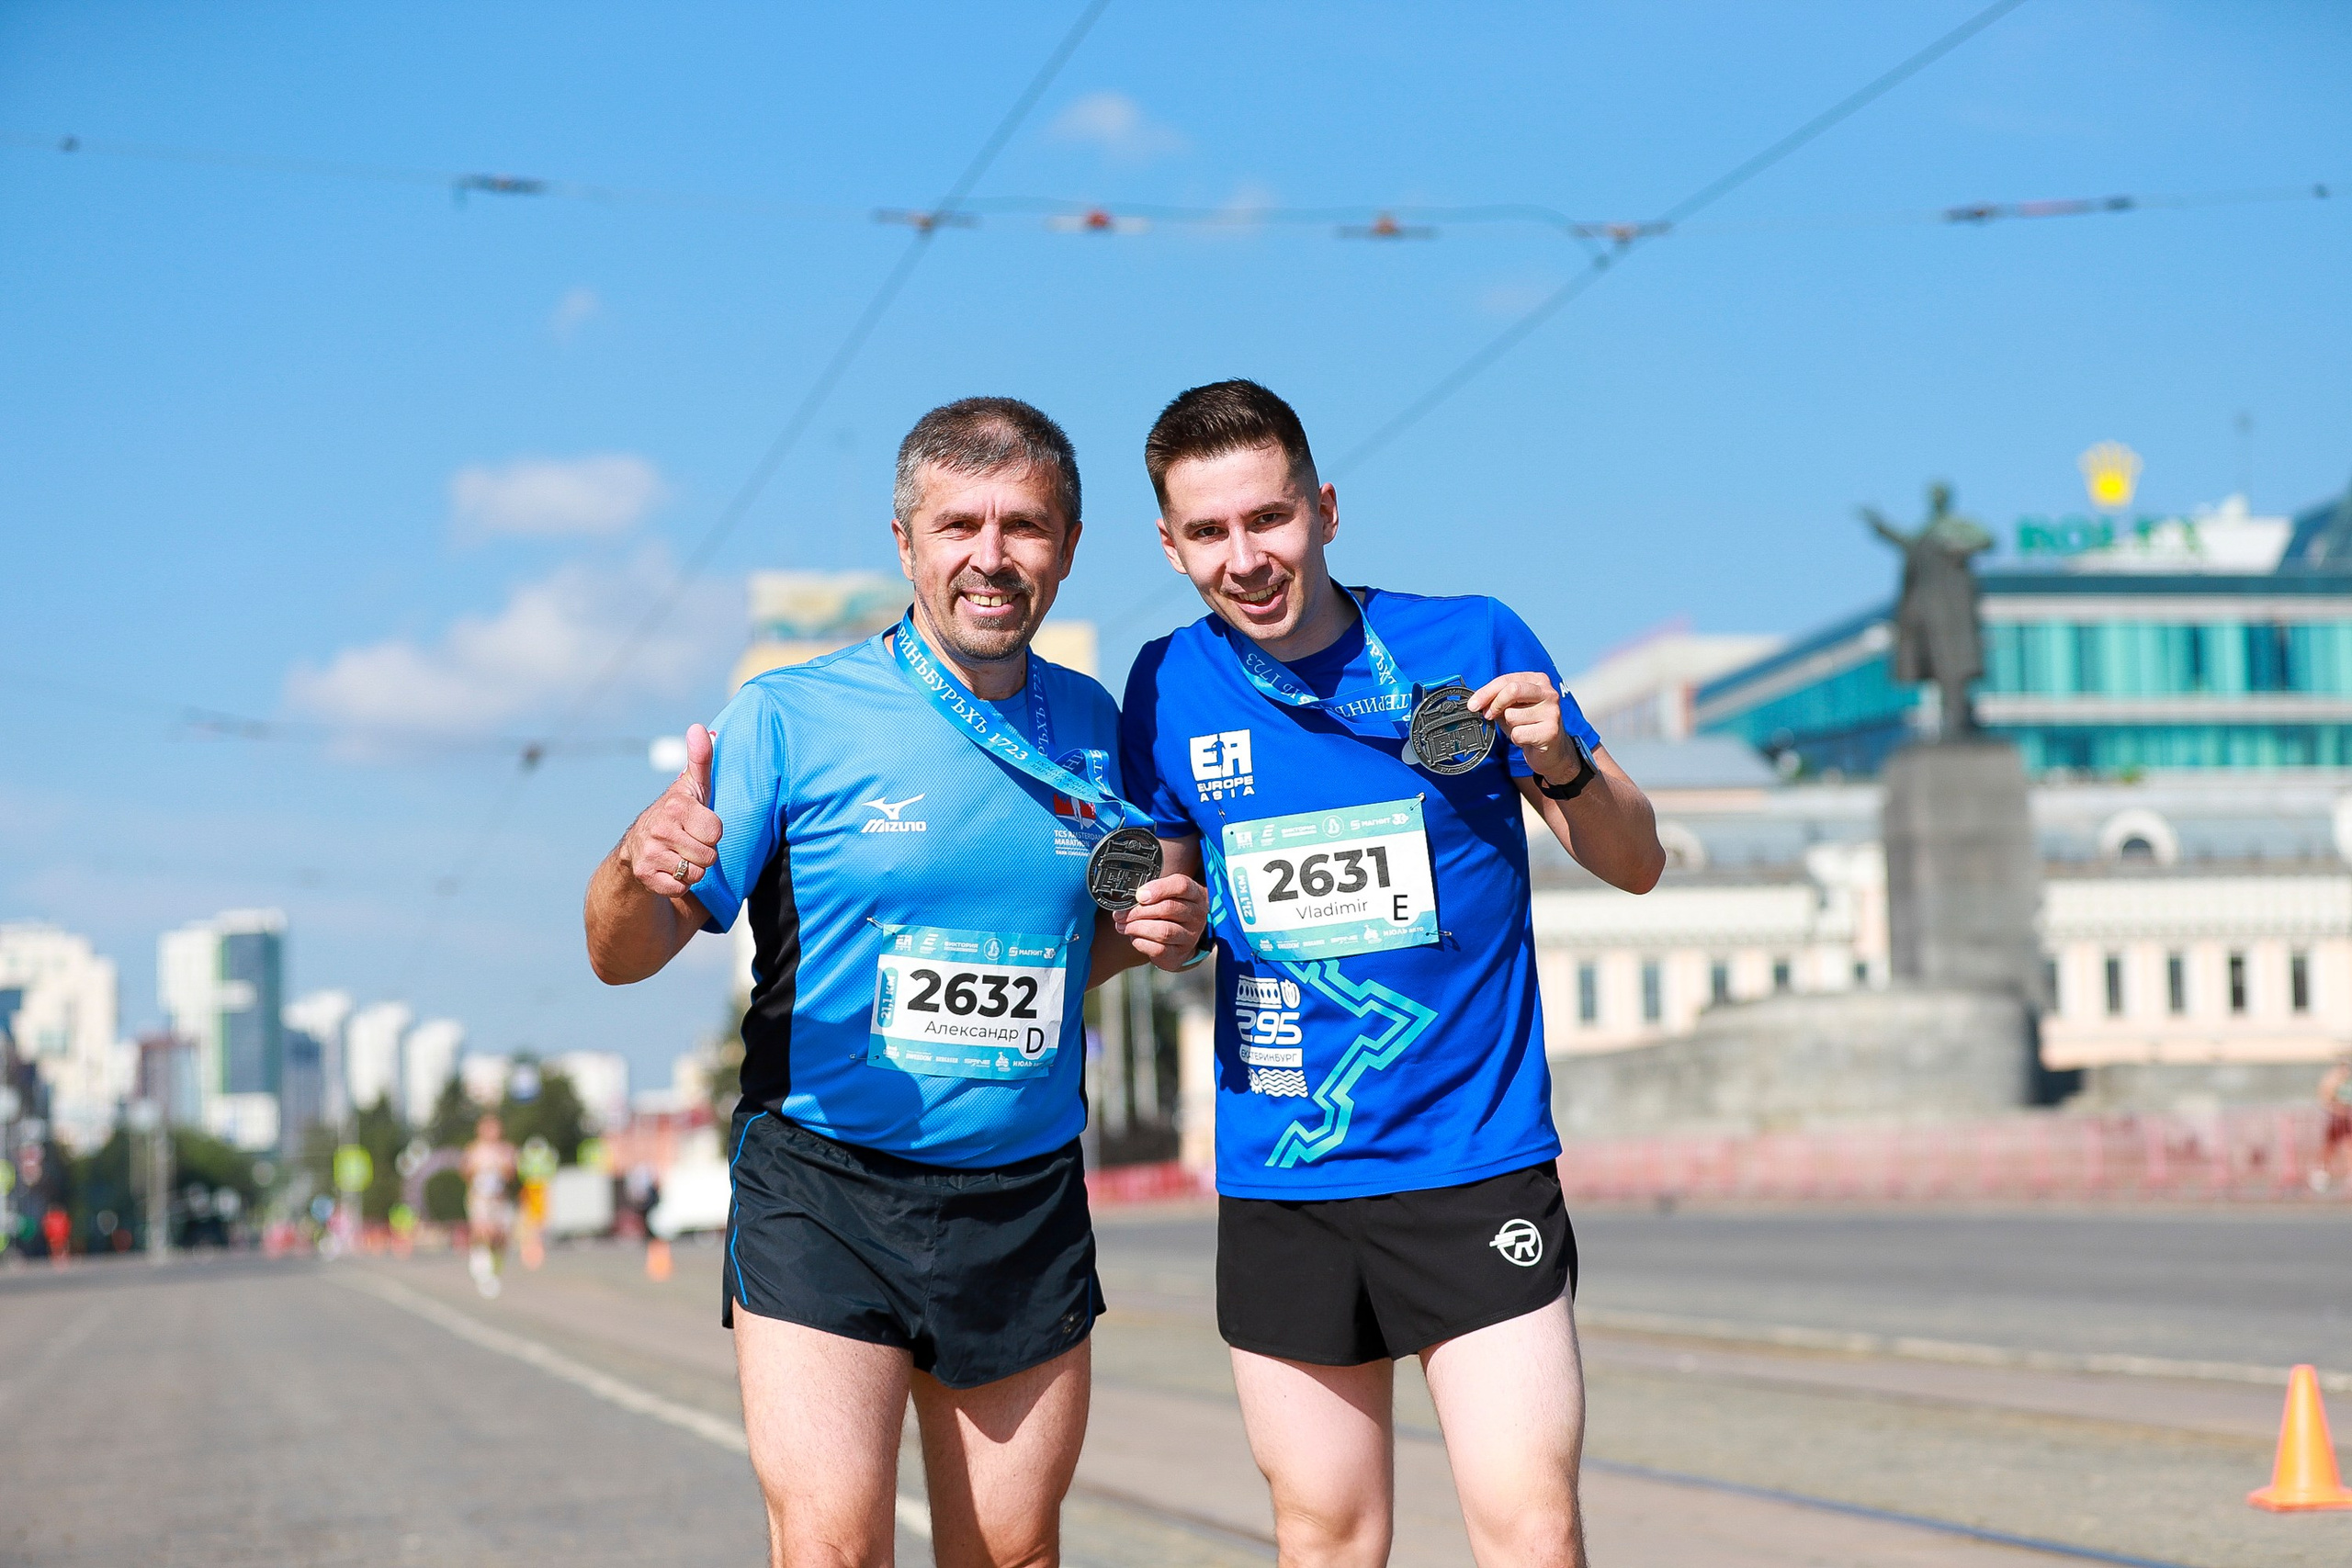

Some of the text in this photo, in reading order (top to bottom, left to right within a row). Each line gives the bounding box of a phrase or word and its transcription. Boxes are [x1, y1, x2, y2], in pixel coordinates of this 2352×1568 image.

[1246, 653, 1282, 688] 1723
[897, 624, 1029, 761] РИНЪБУРЪХЪ 1723
[1335, 692, 1413, 718] ТЕРИНЪ
[1196, 774, 1254, 793] EUROPE
[1200, 785, 1255, 803] ASIA
[1361, 817, 1391, 827] МАГНИТ
[1263, 846, 1391, 903] 2631
[1240, 895, 1254, 918] 21,1
[1295, 898, 1369, 919] Vladimir
[1393, 894, 1409, 921] E
[1383, 928, 1408, 937] ИЮЛЬ
[944, 941, 978, 949] ВИКТОРИЯ
[908, 968, 1038, 1019] 2632
[881, 997, 895, 1020] 21,1
[924, 1021, 1019, 1043] Александр
[1025, 1027, 1045, 1054] D
[1241, 1049, 1297, 1063] ЕКАТЕРИНБУРГ
